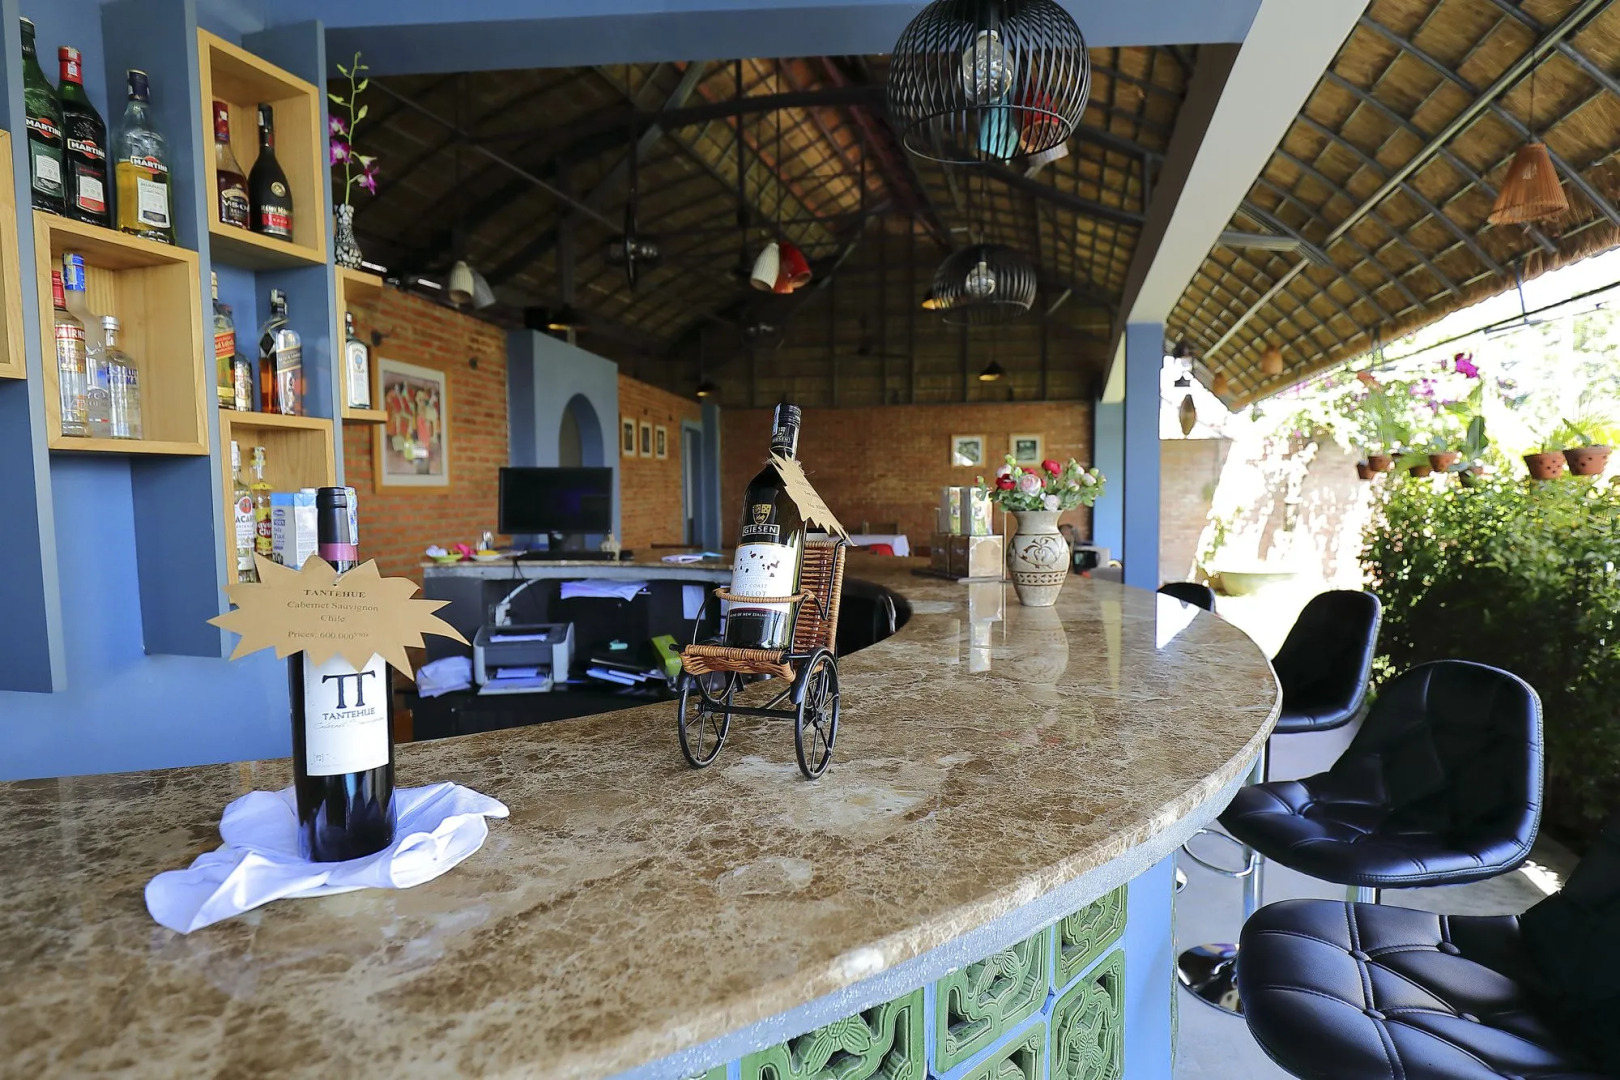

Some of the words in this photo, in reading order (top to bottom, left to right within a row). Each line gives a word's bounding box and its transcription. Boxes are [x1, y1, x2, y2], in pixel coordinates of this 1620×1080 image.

[71, 141, 106, 158] MARTINI
[133, 158, 168, 172] MARTINI
[107, 376, 137, 385] VOKA
[744, 525, 777, 534] GIESEN
[304, 589, 366, 599] TANTEHUE
[287, 601, 329, 609] Cabernet
[331, 602, 379, 613] Sauvignon
[320, 614, 346, 623] Chile
[322, 707, 376, 721] TANTEHUE
